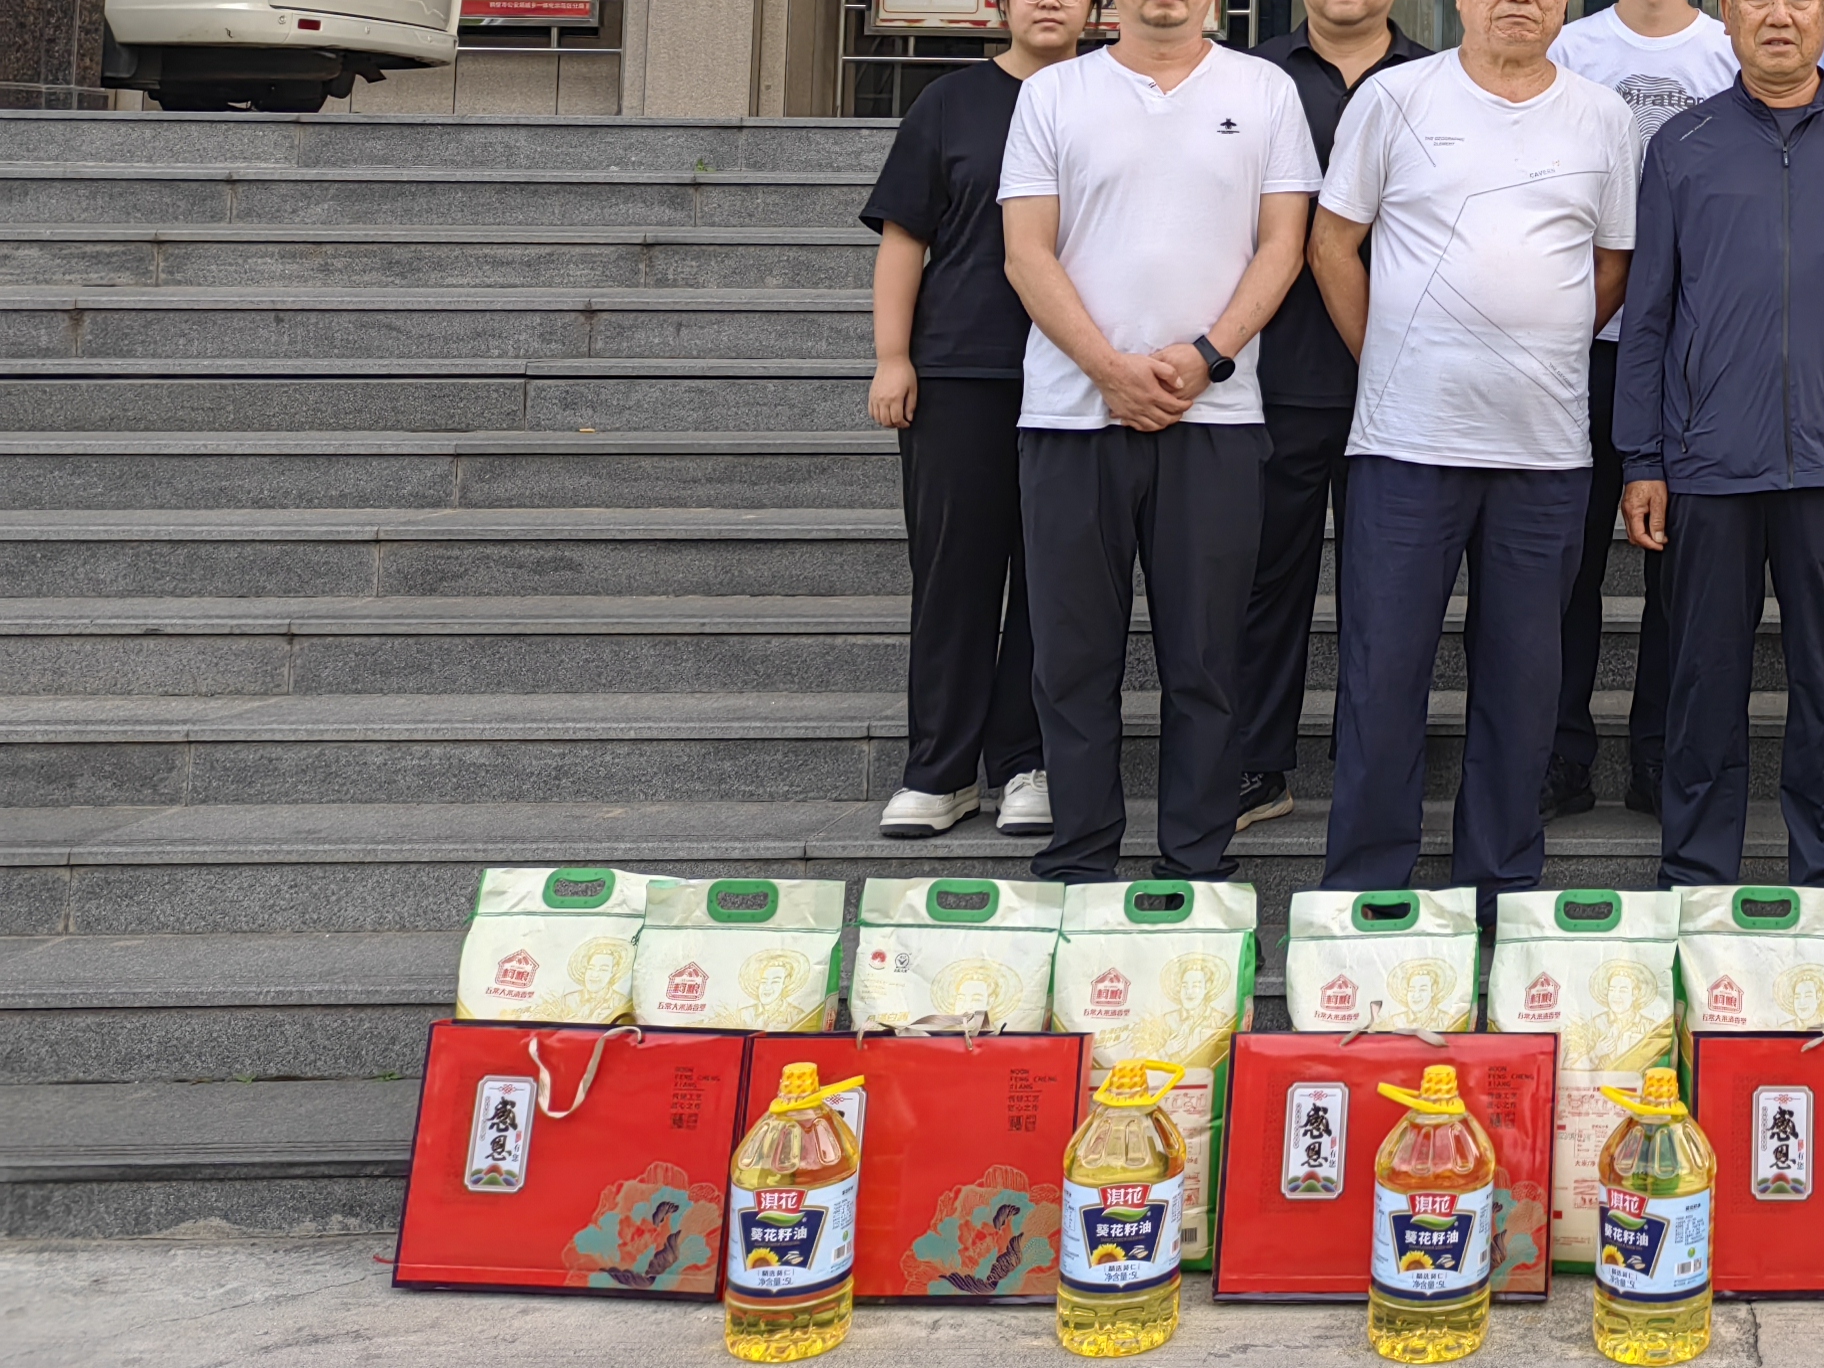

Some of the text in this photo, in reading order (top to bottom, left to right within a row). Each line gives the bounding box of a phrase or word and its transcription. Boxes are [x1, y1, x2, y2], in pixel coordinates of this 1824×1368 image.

[485, 1096, 518, 1161] 感恩
[1299, 1102, 1333, 1168] 感恩
[1766, 1106, 1799, 1170] 感恩
[760, 1191, 798, 1209] 淇花
[1106, 1187, 1143, 1205] 淇花
[1415, 1194, 1450, 1213] 淇花
[1610, 1191, 1640, 1214] 淇花
[750, 1226, 808, 1242] 葵花籽油
[1096, 1220, 1152, 1237] 葵花籽油
[1404, 1229, 1460, 1246] 葵花籽油
[1604, 1223, 1649, 1247] 葵花籽油
